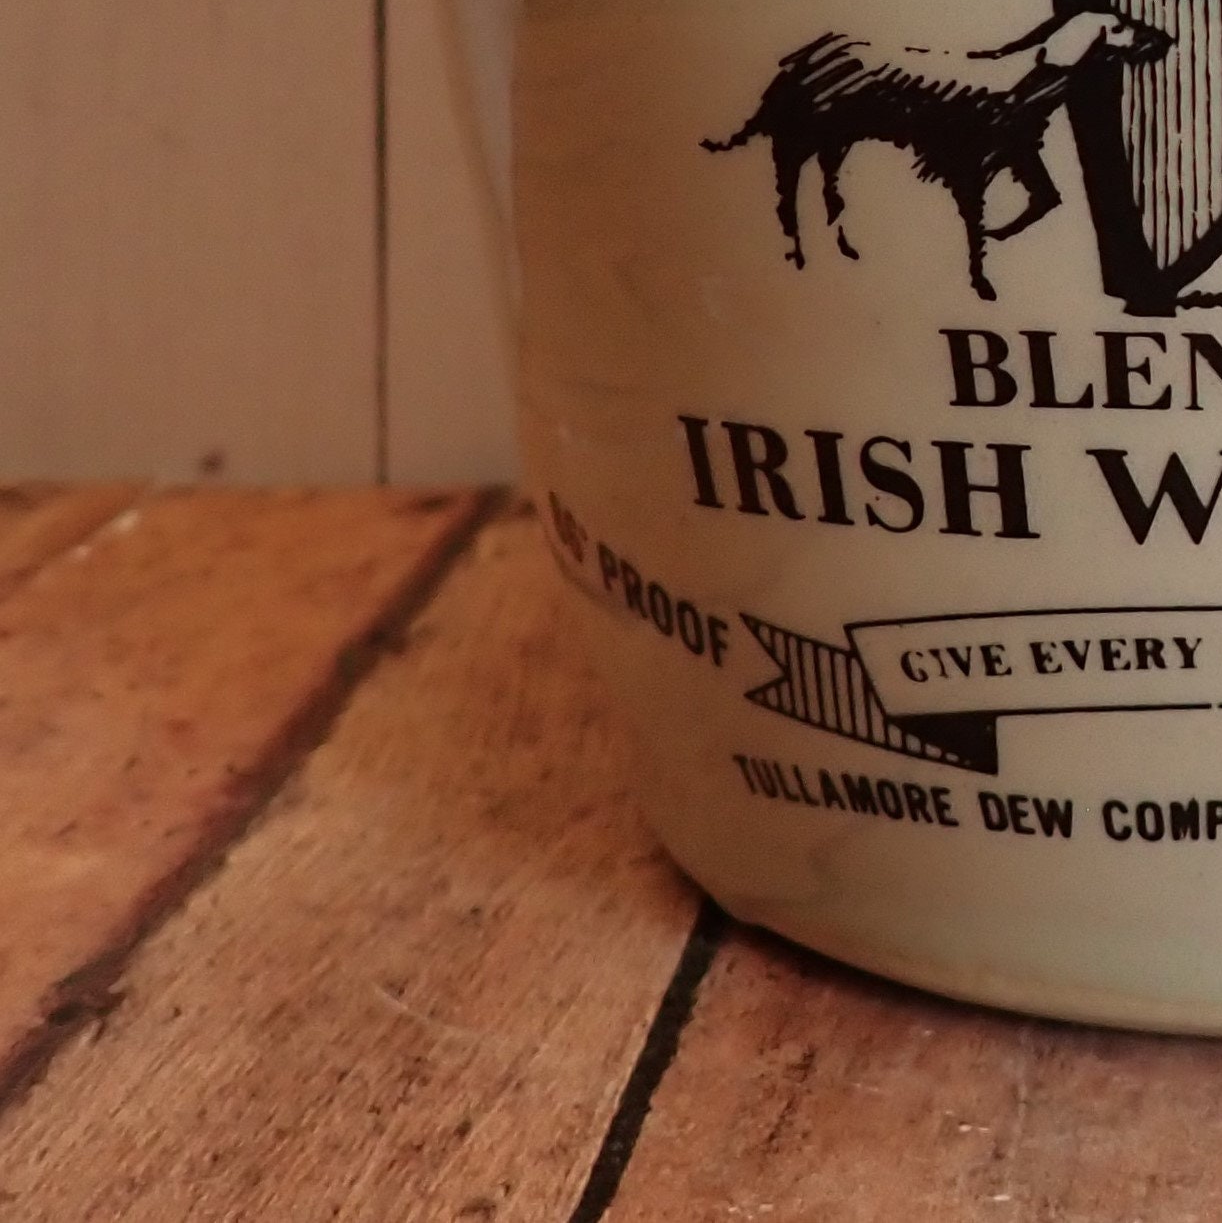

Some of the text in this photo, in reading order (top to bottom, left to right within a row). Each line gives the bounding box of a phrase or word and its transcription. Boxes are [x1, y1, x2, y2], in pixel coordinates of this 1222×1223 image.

[677, 416, 1040, 539] IRISH
[597, 541, 728, 667] PROOF
[901, 643, 1012, 682] GIVE
[1030, 637, 1202, 674] EVERY
[733, 754, 959, 826] TULLAMORE
[977, 790, 1073, 838] DEW
